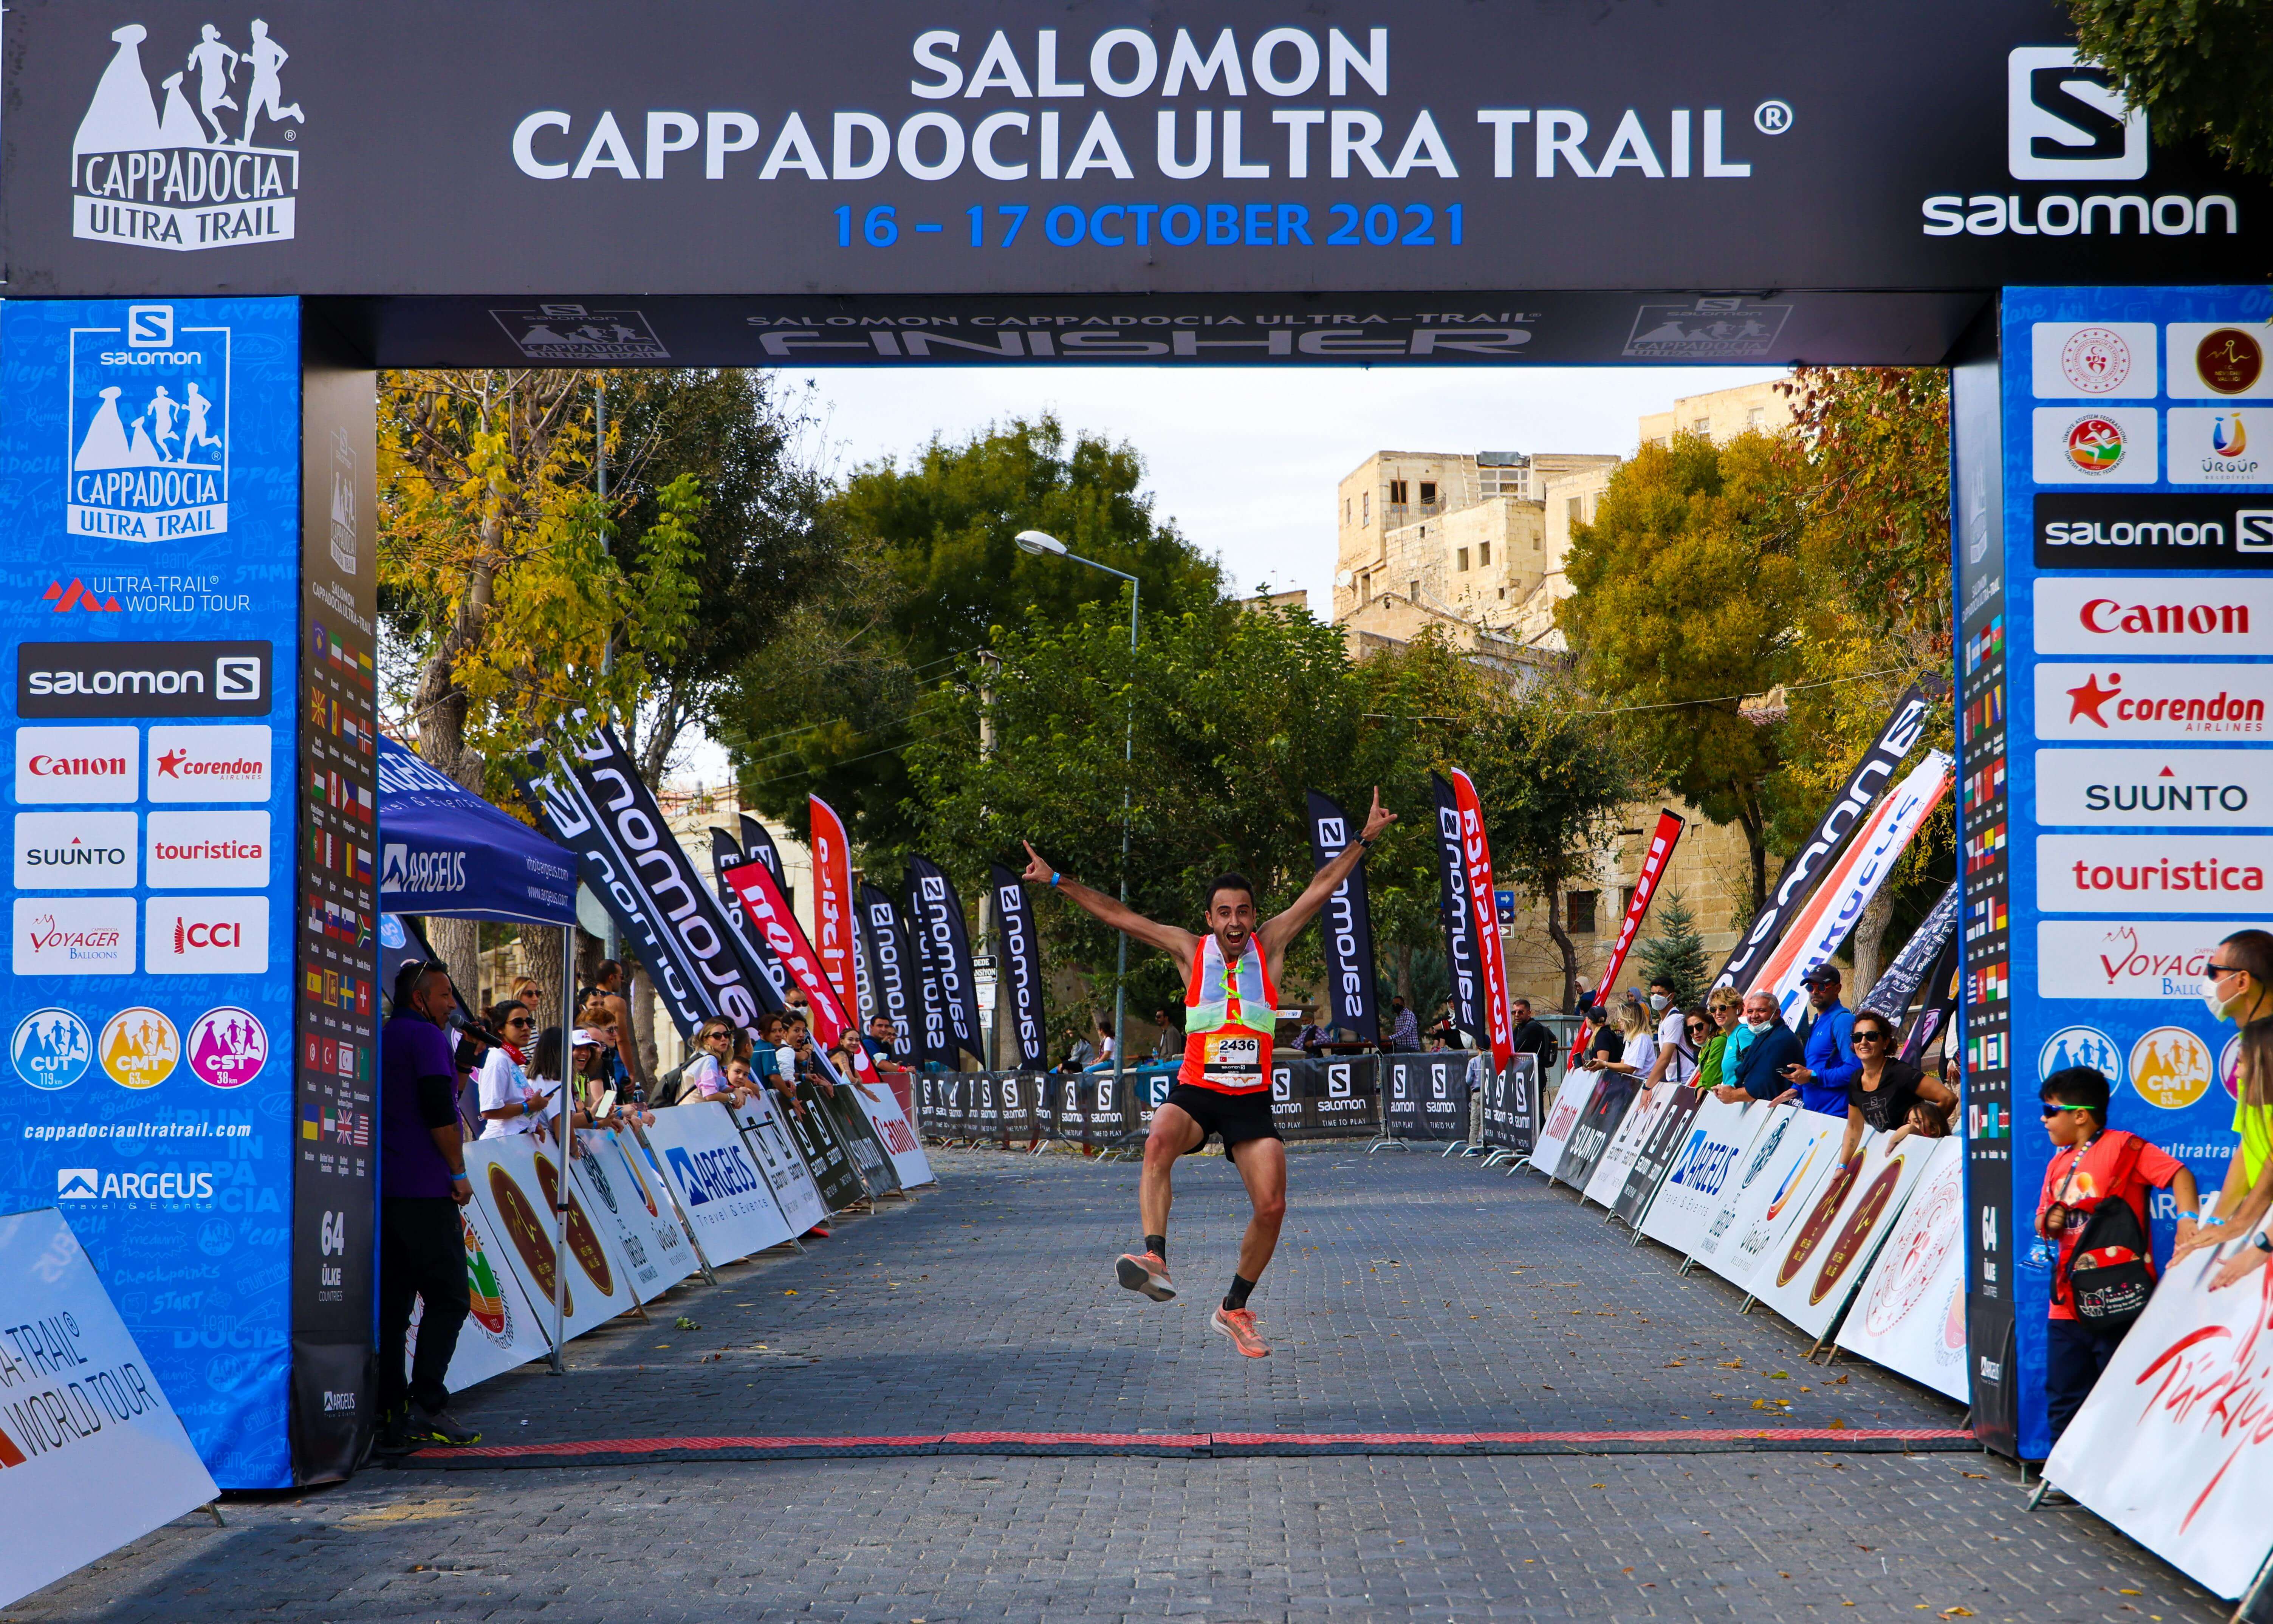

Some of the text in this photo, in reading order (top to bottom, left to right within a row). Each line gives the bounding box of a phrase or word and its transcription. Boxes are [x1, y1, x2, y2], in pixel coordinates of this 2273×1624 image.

[911, 28, 1387, 99] SALOMON
[512, 110, 1134, 181] CAPPADOCIA
[1157, 110, 1459, 180] ULTRA
[86, 151, 284, 202] CAPPADOCIA
[90, 203, 280, 245] ULTRA TRAIL
[833, 203, 1463, 248] 16 17 OCTOBER 2021
[1922, 195, 2237, 236] salomon
[747, 316, 958, 326] SALOMON
[970, 315, 1245, 326] CAPPADOCIA
[759, 329, 1531, 356] FINISHER
[1634, 342, 1761, 350] CAPPADOCIA
[101, 352, 201, 365] salomon
[2100, 415, 2128, 444] FEDERASYONU
[2103, 451, 2126, 475] FEDERATION
[2202, 458, 2259, 472] ÜRGÜP
[77, 471, 218, 507] CAPPADOCIA
[81, 509, 215, 538] ULTRA TRAIL
[2045, 522, 2223, 546] salomon
[332, 522, 355, 555] CAPPADOCIA
[126, 595, 250, 612] WORLD TOUR
[331, 581, 355, 607] SALOMON
[313, 581, 372, 636] CAPPADOCIA ULTRA-TRAIL
[2079, 598, 2249, 634] Canon
[29, 670, 204, 694] salomon
[2117, 692, 2264, 721] corendon
[2185, 722, 2263, 732] AIRLINES
[29, 755, 126, 776] Canon
[184, 758, 262, 775] corendon
[2085, 784, 2248, 811] SUUNTO
[26, 848, 125, 865] SUUNTO
[155, 840, 262, 860] touristica
[403, 851, 466, 892] ARGEUS
[524, 855, 568, 882] info@argeus.com
[2072, 857, 2264, 891] touristica
[527, 886, 568, 907] www.argeus.com
[187, 923, 240, 947] CCI
[1219, 1040, 1256, 1051] 2436
[31, 1056, 72, 1071] CUT
[116, 1056, 162, 1070] CMT
[206, 1055, 248, 1069] CST
[2147, 1075, 2193, 1090] CMT
[1318, 1099, 1366, 1112] salomon
[1546, 1095, 1578, 1142] Canon
[25, 1122, 251, 1141] cappadociaultratrail.com
[872, 1116, 919, 1156] Canon
[1570, 1124, 1607, 1163] SUUNTO
[850, 1137, 883, 1171] SUUNTO
[693, 1146, 757, 1200] ARGEUS
[1682, 1142, 1739, 1196] ARGEUS
[101, 1172, 214, 1199] ARGEUS
[696, 1197, 768, 1228] Travel & Events
[322, 1211, 344, 1256] 64
[1982, 1205, 1997, 1251] 64
[322, 1263, 341, 1286] ÜLKE
[319, 1291, 343, 1302] COUNTRIES
[3, 1363, 159, 1456] WORLD TOUR
[333, 1392, 355, 1411] ARGEUS
